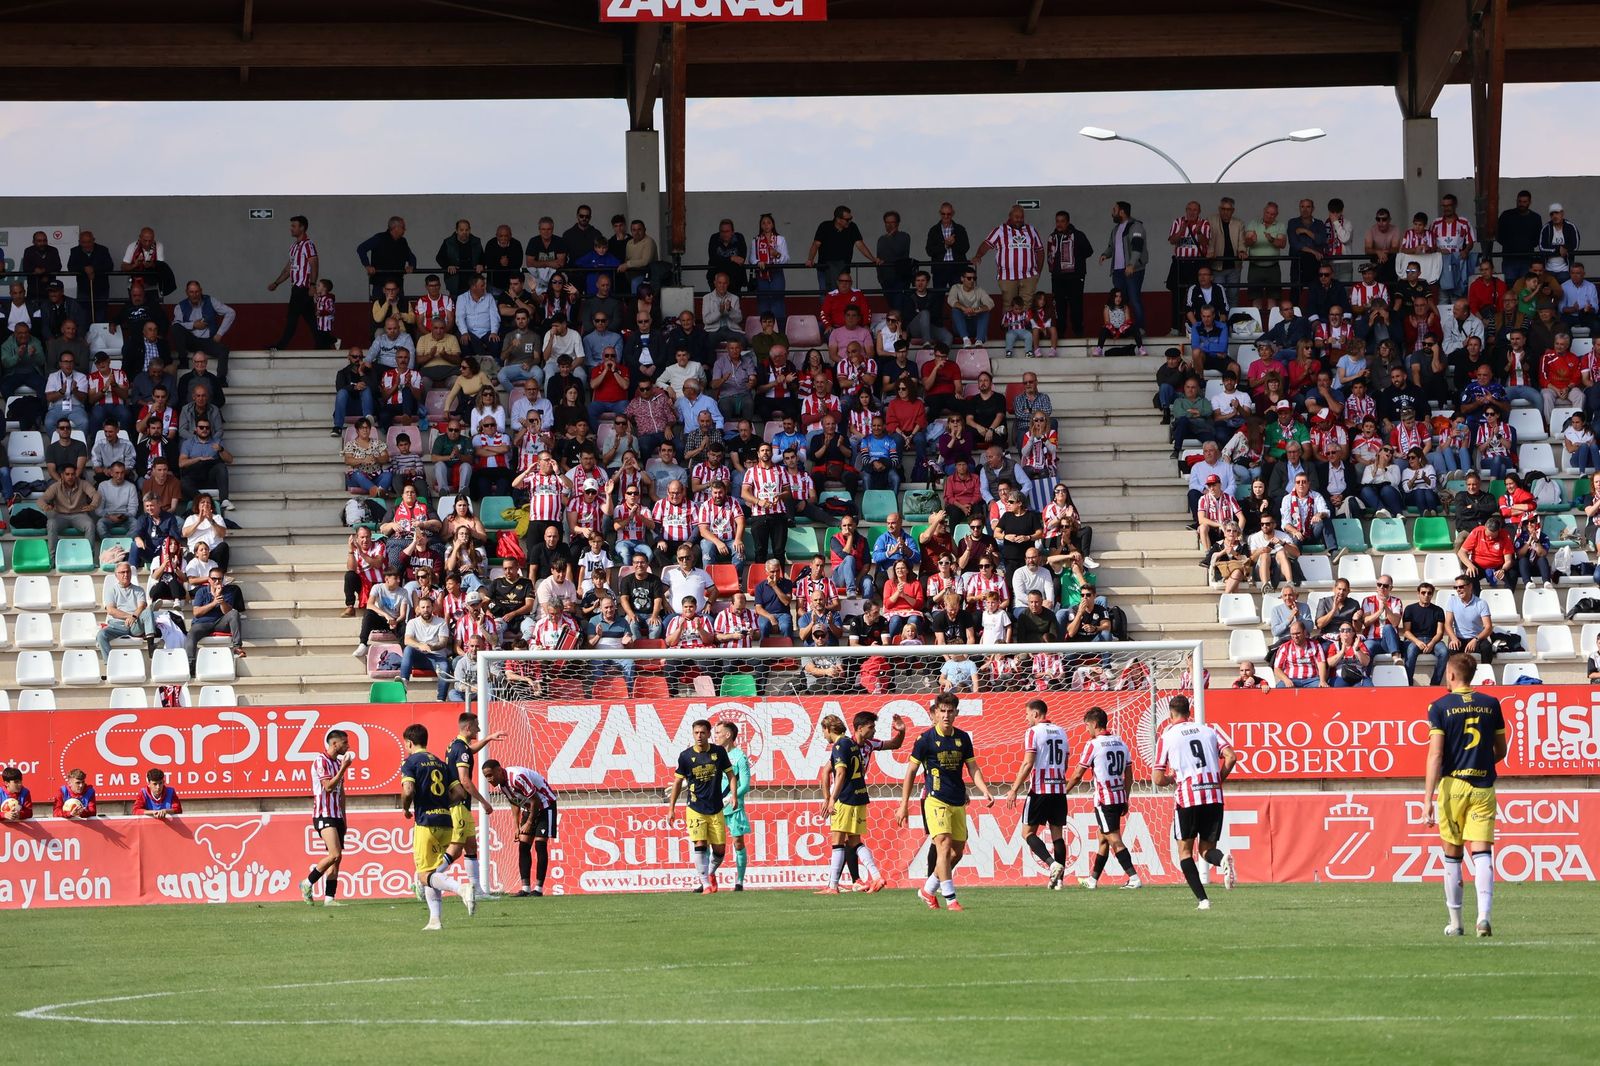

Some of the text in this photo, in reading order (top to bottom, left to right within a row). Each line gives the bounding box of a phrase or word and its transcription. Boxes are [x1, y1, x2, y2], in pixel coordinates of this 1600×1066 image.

[1462, 715, 1482, 751] 5
[1046, 739, 1063, 765] 16
[1106, 750, 1125, 776] 20
[1189, 739, 1207, 769] 9
[95, 767, 371, 787] EMBTIDOS Y JAMES
[430, 768, 445, 797] 8
[0, 831, 81, 863] Joven
[20, 878, 37, 909] y
[43, 868, 111, 902] León
